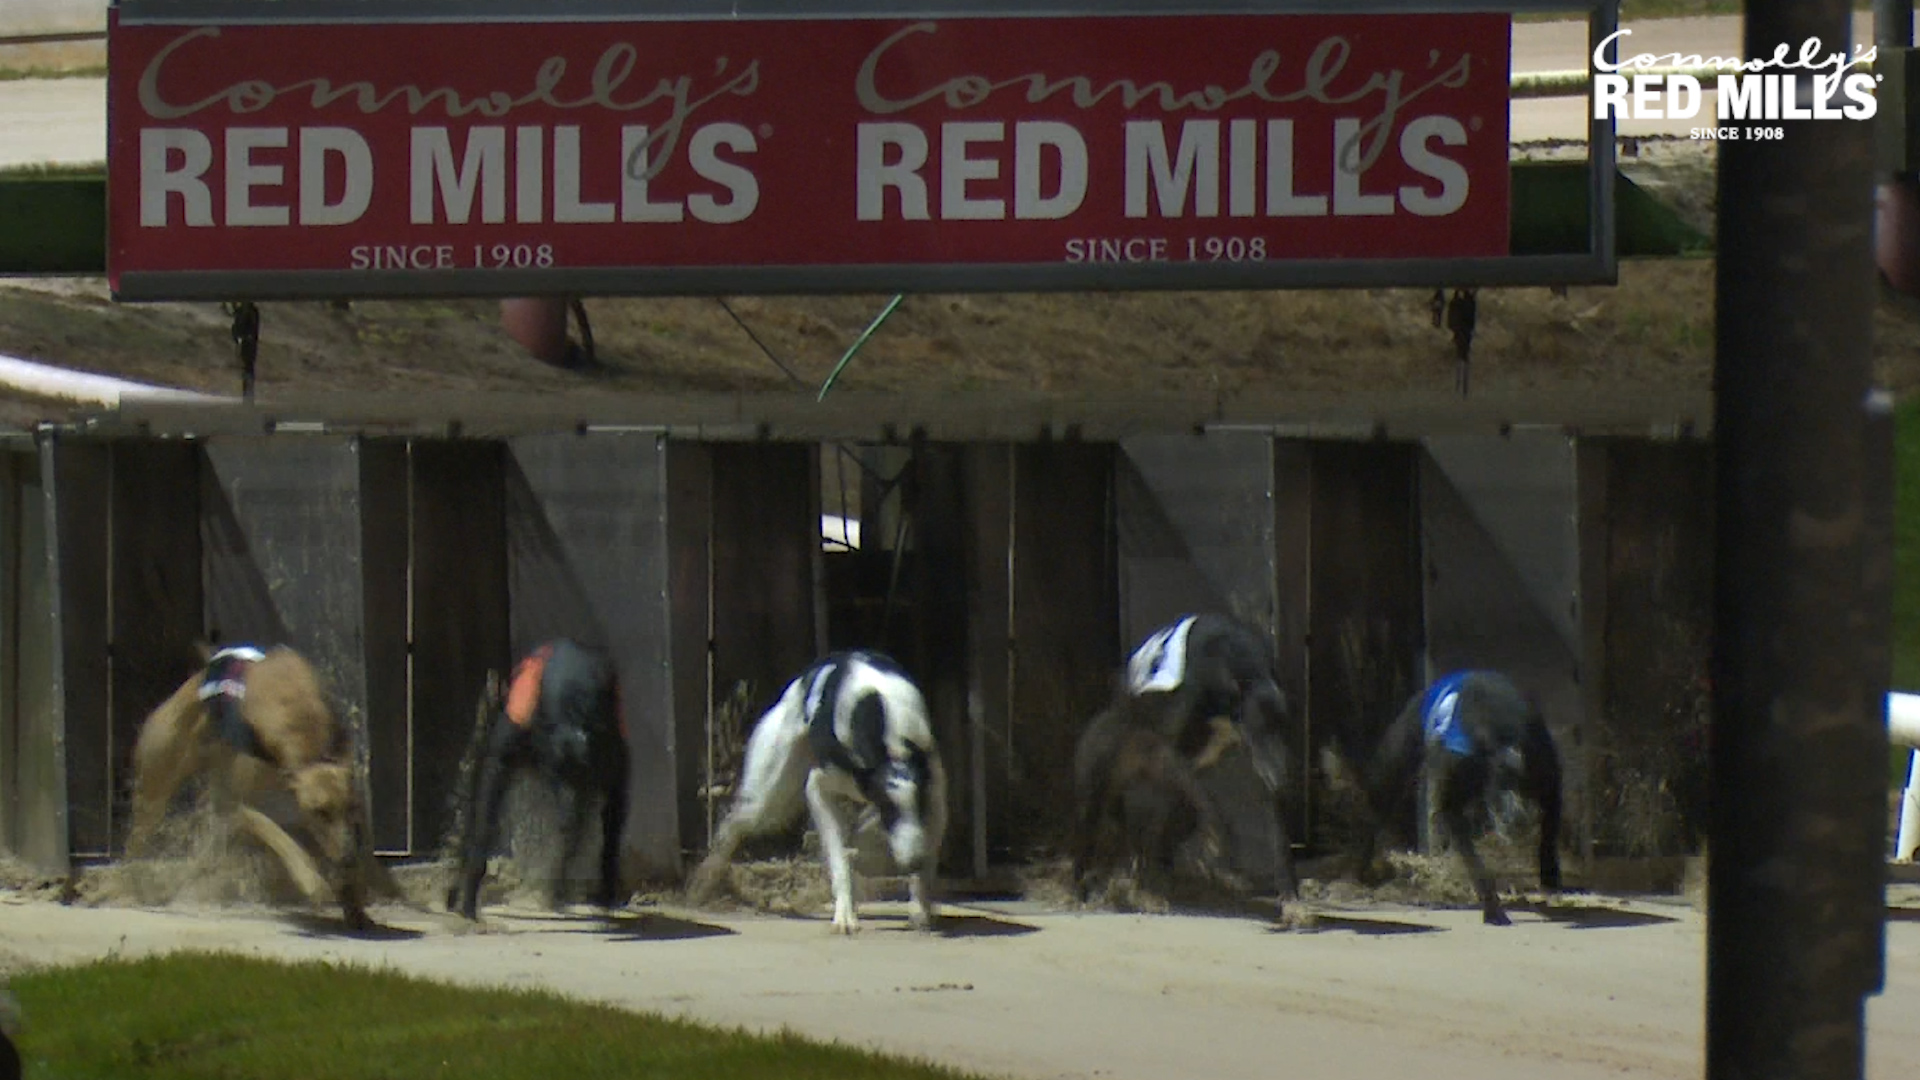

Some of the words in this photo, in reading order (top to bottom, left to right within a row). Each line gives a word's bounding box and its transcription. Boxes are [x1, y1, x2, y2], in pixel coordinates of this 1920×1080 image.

[138, 26, 760, 181] Connolly's
[855, 22, 1471, 174] Connolly's
[140, 127, 373, 227] RED
[410, 123, 759, 225] MILLS
[856, 121, 1089, 220] RED
[1124, 115, 1470, 217] MILLS
[350, 245, 454, 269] SINCE
[473, 243, 555, 268] 1908
[1065, 238, 1168, 263] SINCE
[1186, 237, 1267, 262] 1908
